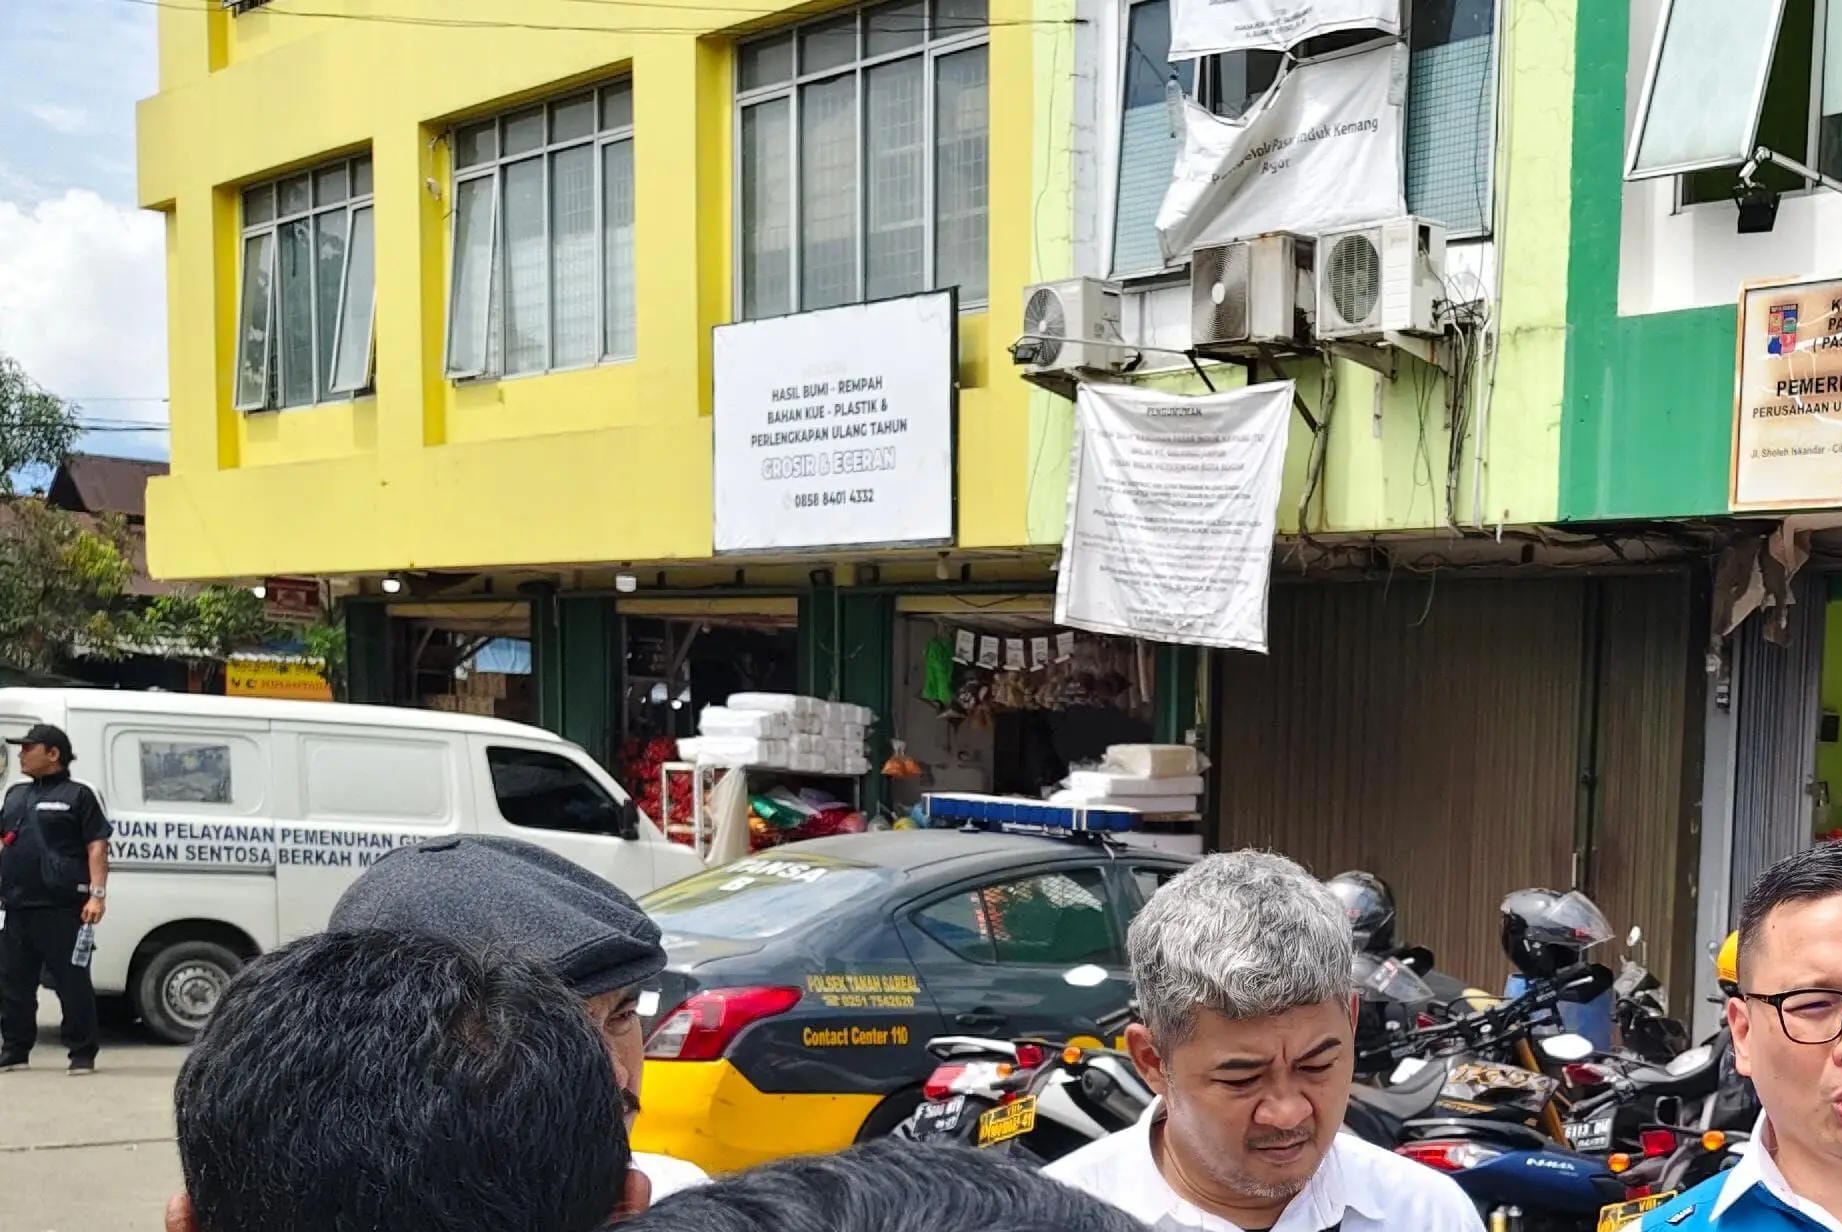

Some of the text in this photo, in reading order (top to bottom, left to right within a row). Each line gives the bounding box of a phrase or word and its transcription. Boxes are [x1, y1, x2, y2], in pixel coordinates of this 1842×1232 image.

[1333, 118, 1379, 138] Kemang
[771, 385, 801, 402] HASIL
[802, 382, 829, 399] BUMI
[838, 376, 883, 394] REMPAH
[767, 408, 802, 424] BAHAN
[805, 405, 825, 420] KUE
[833, 399, 878, 417] PLASTIK
[880, 397, 888, 412] &
[1752, 402, 1830, 419] PERUSAHAAN
[751, 418, 908, 448] PERLENGKAPAN ULANG TAHUN
[762, 446, 896, 480] GROSIR & ECERAN
[794, 488, 875, 508] 0858 8401 4332
[165, 823, 274, 843] PELAYANAN
[281, 828, 393, 848] PEMENUHAN
[185, 844, 273, 864] SENTOSA
[279, 848, 352, 867] BERKAH
[806, 975, 845, 993] POLSEK
[803, 1025, 910, 1047] Contact Center 110
